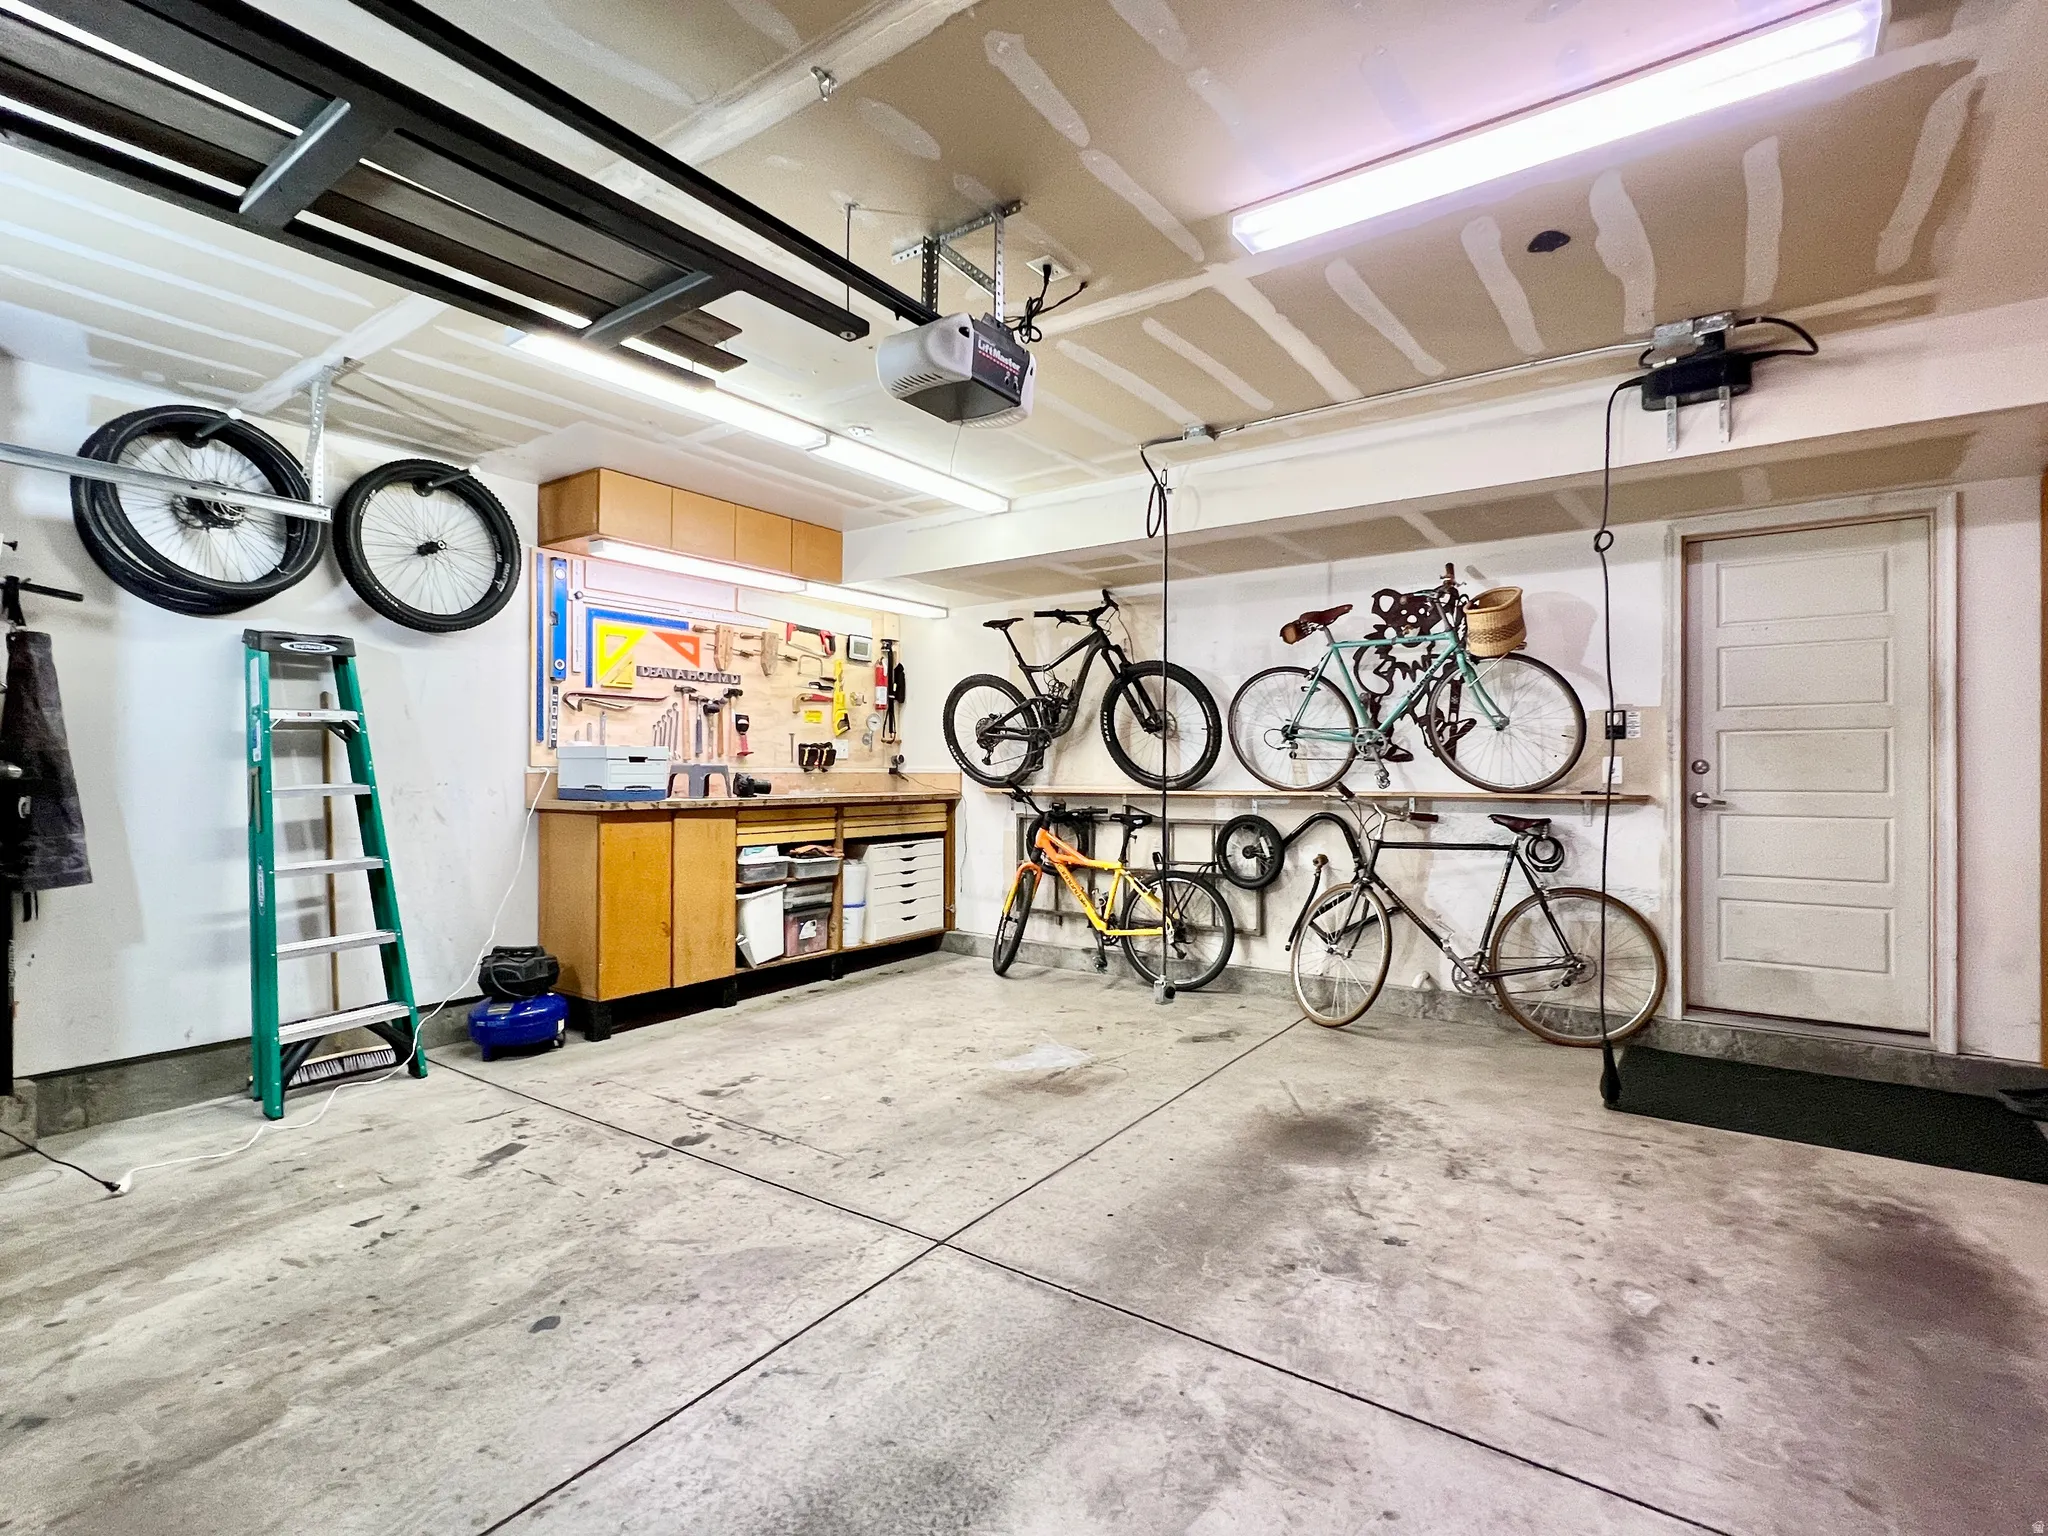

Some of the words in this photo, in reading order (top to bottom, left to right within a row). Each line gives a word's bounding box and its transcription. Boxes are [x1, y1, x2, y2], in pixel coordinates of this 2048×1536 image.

[978, 339, 1021, 371] LiftMaster
[641, 666, 672, 679] DEAN
[675, 670, 687, 680] A
